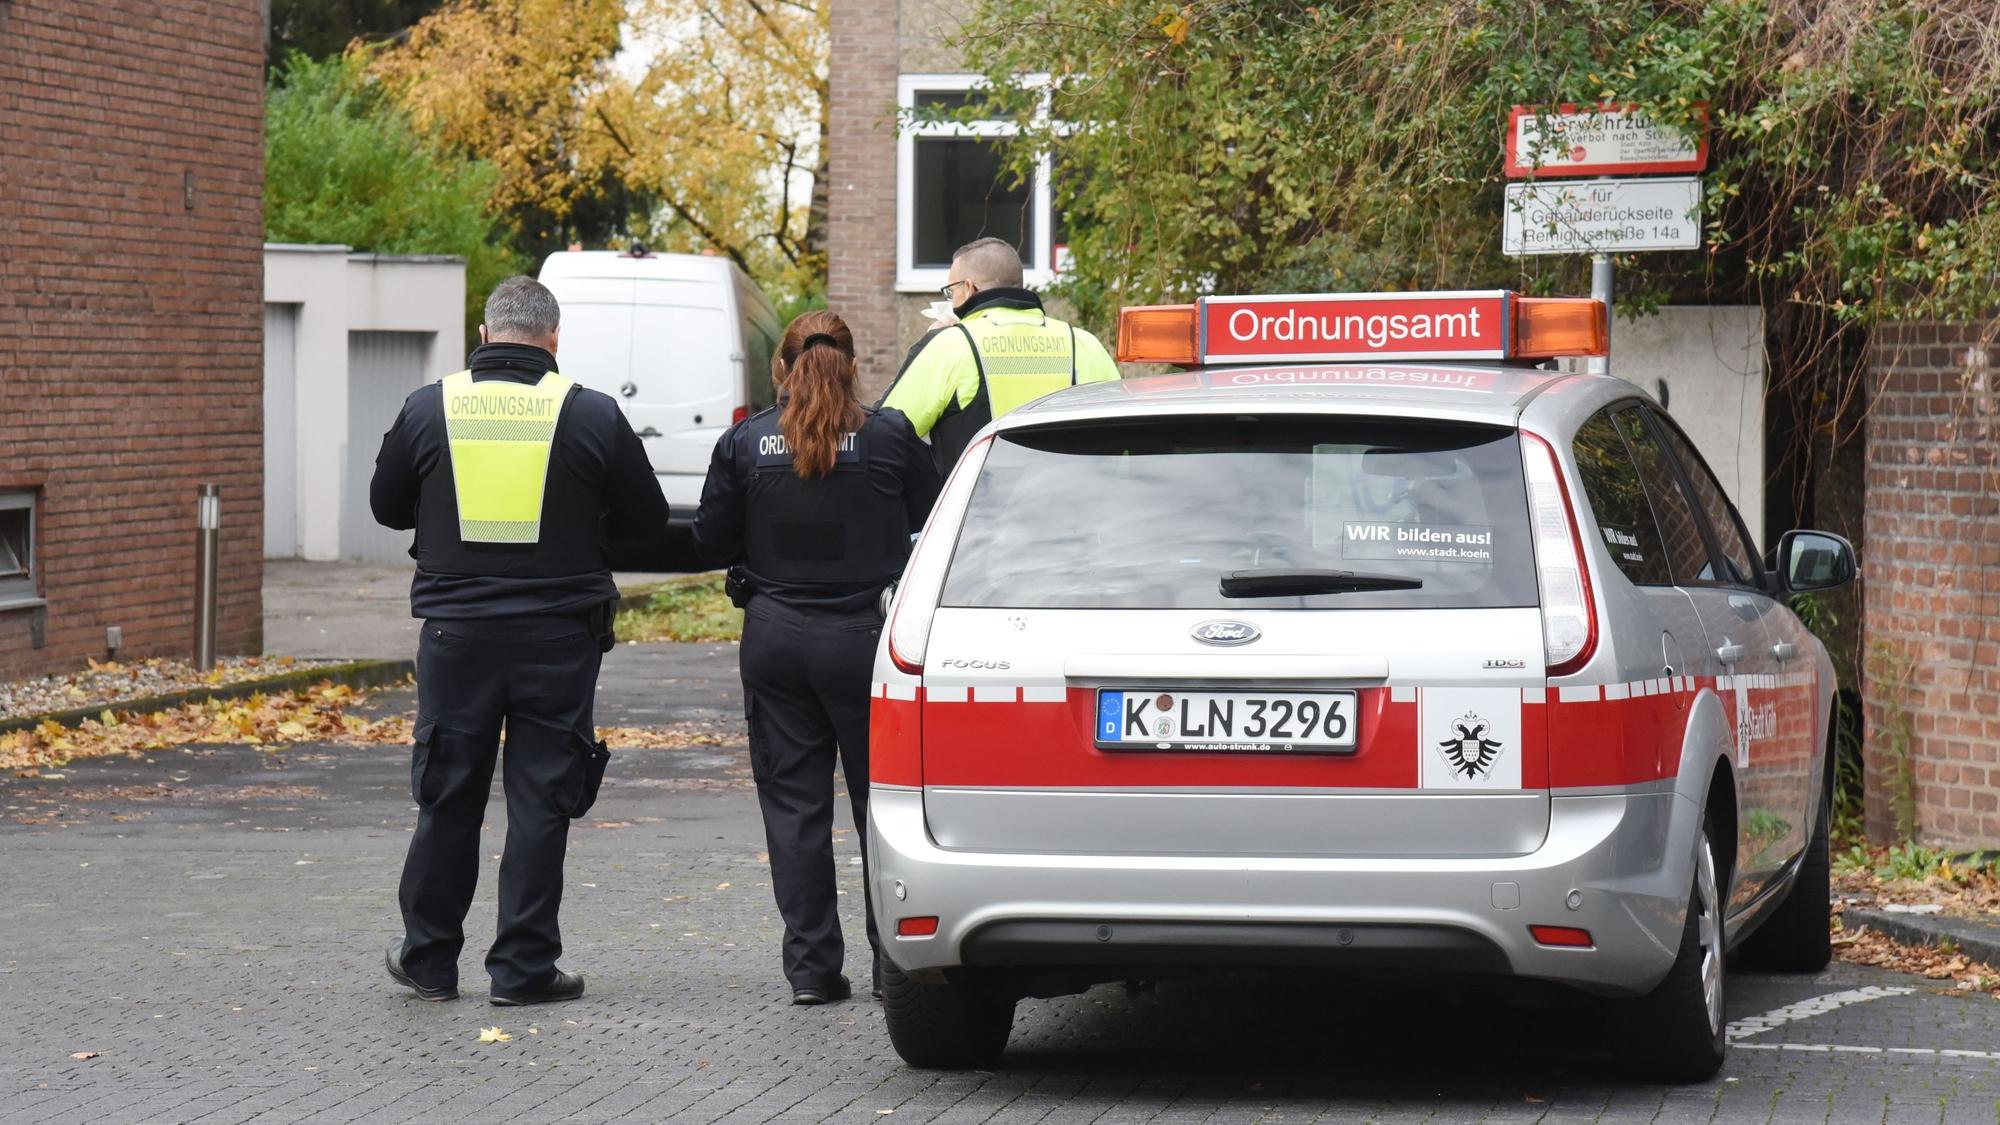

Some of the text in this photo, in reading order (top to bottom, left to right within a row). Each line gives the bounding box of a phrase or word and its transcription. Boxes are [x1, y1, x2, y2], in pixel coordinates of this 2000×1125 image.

[1524, 115, 1657, 132] Feuerwehrzu
[1613, 132, 1638, 141] nach
[1592, 188, 1613, 202] für
[1532, 206, 1673, 223] Gebäuderückseite
[1524, 226, 1679, 244] Remigiusstraße 14a
[1228, 306, 1481, 347] Ordnungsamt
[983, 336, 1065, 353] ORDNUNGSAMT
[452, 395, 554, 416] ORDNUNGSAMT
[759, 432, 857, 456] ORDNMT
[1347, 525, 1491, 545] WIR bilden aus!
[1397, 547, 1490, 559] www.stadt.koeln
[1205, 623, 1246, 639] Ford
[941, 659, 1012, 671] FOCUS
[1482, 658, 1527, 669] TDCi
[1125, 698, 1347, 738] K LN 3296
[1105, 721, 1115, 733] D
